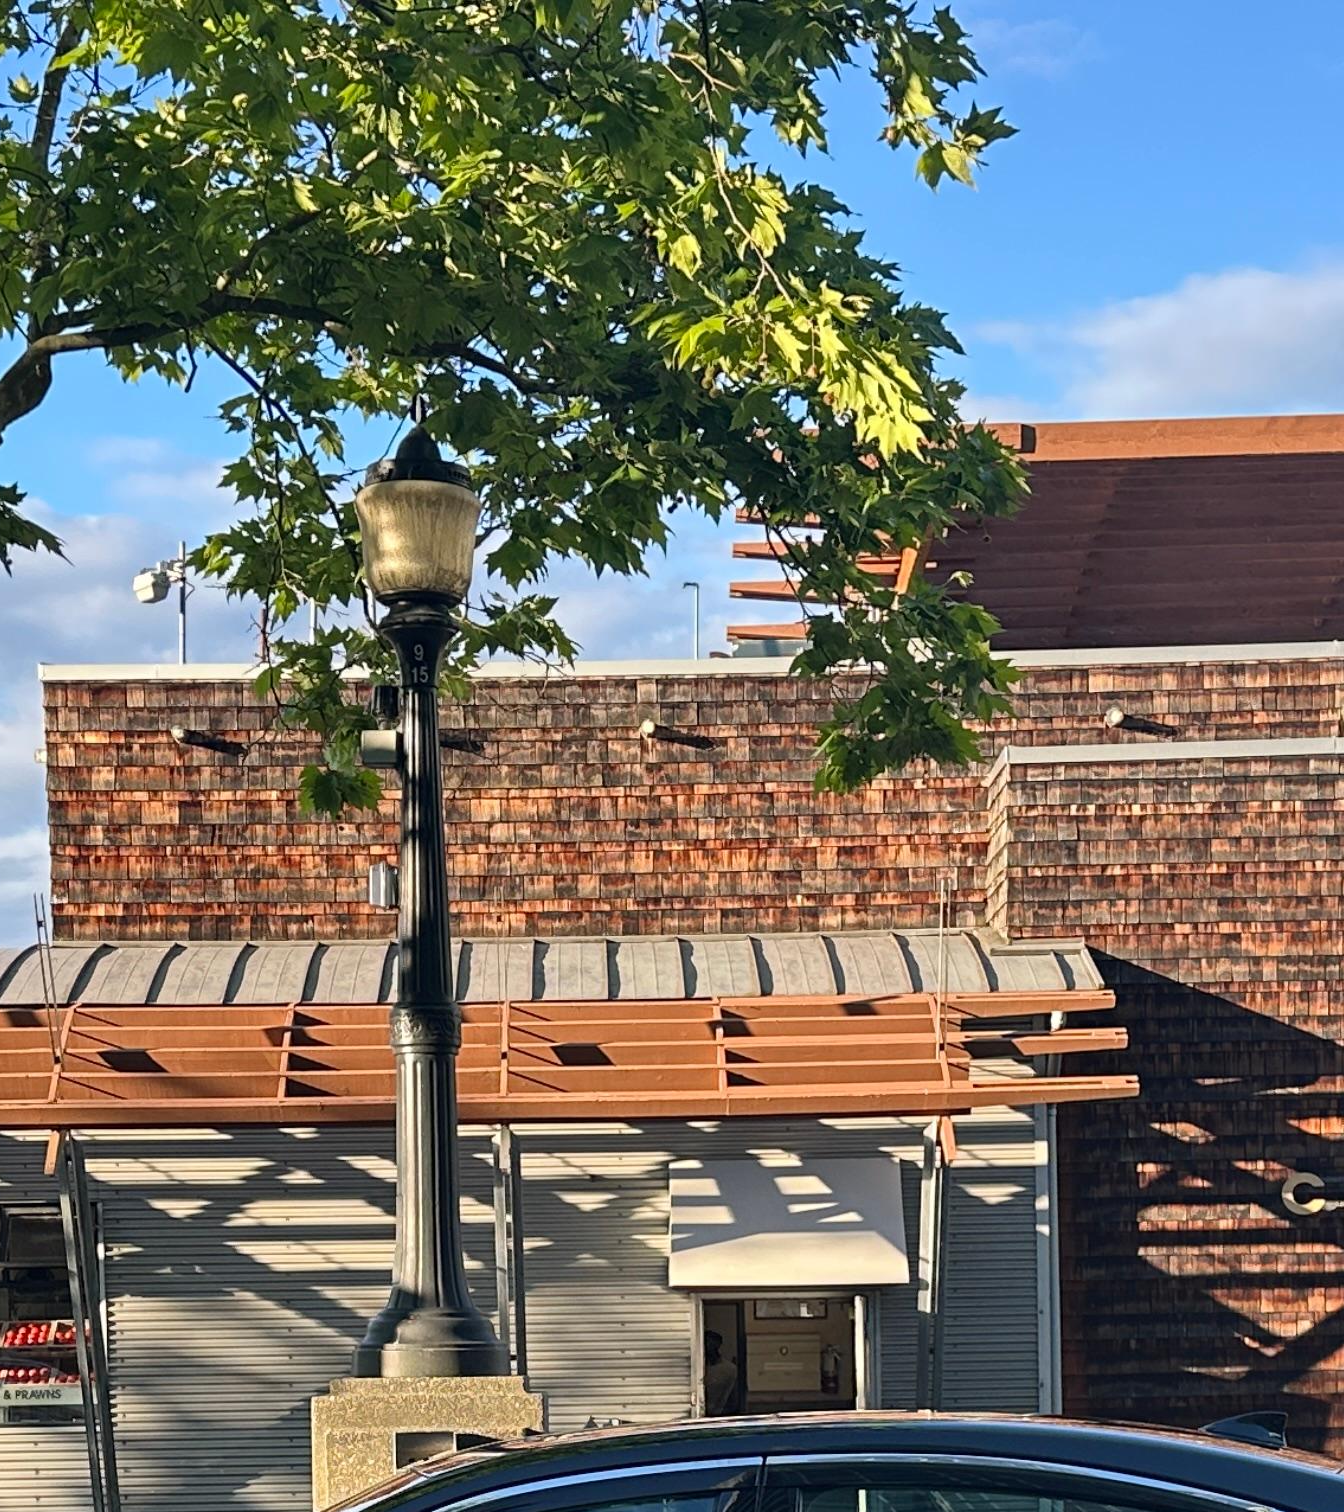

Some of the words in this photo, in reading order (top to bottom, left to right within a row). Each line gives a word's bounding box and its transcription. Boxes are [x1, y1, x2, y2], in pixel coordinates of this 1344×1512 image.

[413, 644, 424, 661] 9
[411, 665, 429, 683] 15
[3, 1390, 11, 1400] &
[15, 1389, 62, 1400] PRAWNS
